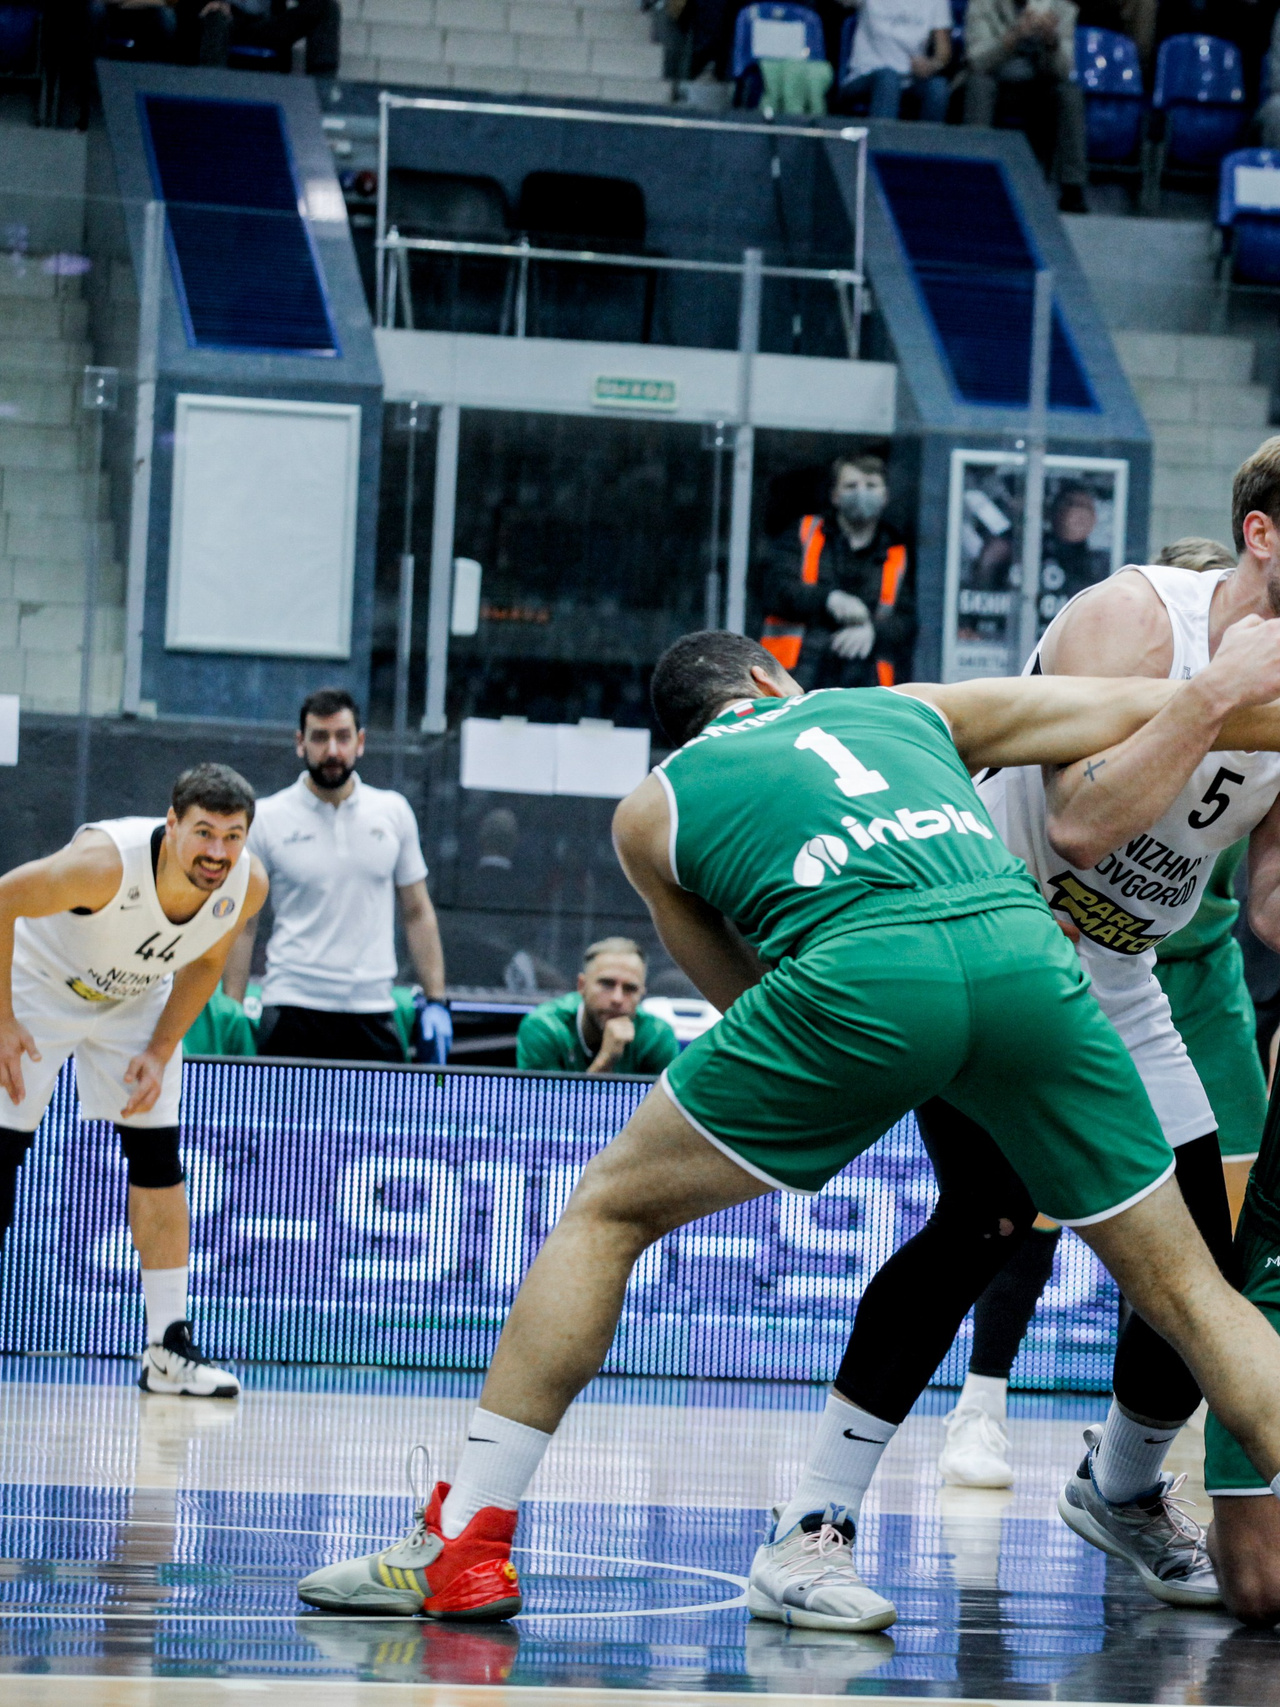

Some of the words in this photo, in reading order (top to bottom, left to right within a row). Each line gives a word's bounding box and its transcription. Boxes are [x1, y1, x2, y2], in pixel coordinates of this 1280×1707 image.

[793, 726, 890, 798] 1
[1187, 766, 1246, 830] 5
[1094, 852, 1198, 908] OVGOROD
[1117, 833, 1210, 883] NIZHN
[1059, 876, 1146, 934] PARI
[135, 930, 183, 962] 44
